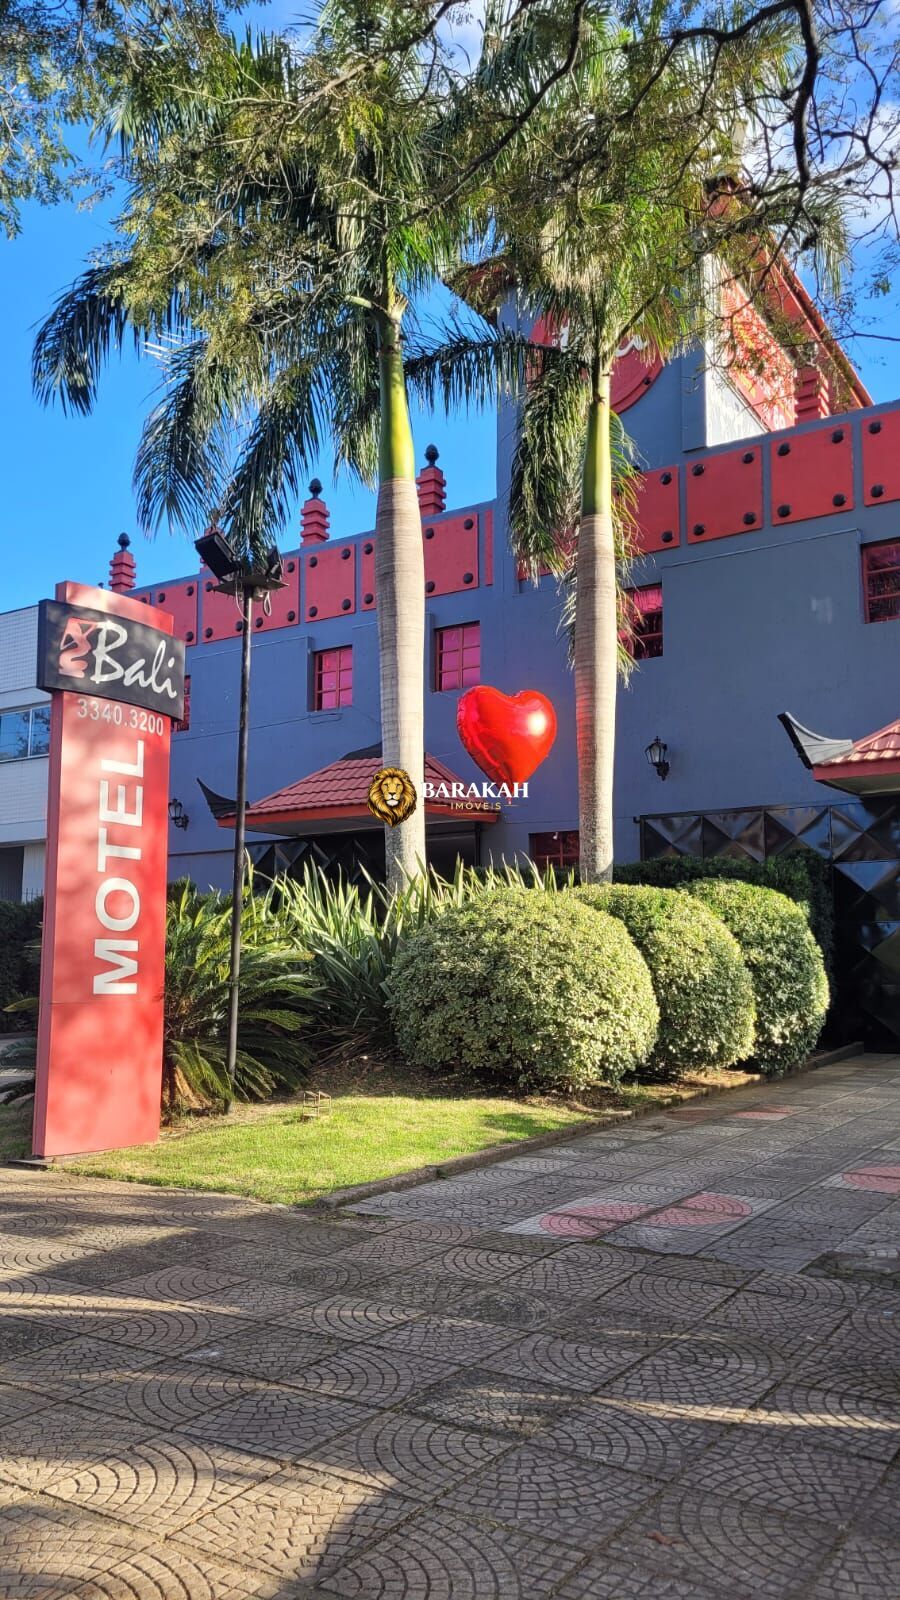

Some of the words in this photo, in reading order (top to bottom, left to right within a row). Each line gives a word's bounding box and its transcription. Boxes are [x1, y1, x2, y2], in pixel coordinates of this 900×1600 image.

[91, 620, 178, 698] Bali
[78, 700, 164, 736] 3340.3200
[93, 740, 145, 995] MOTEL
